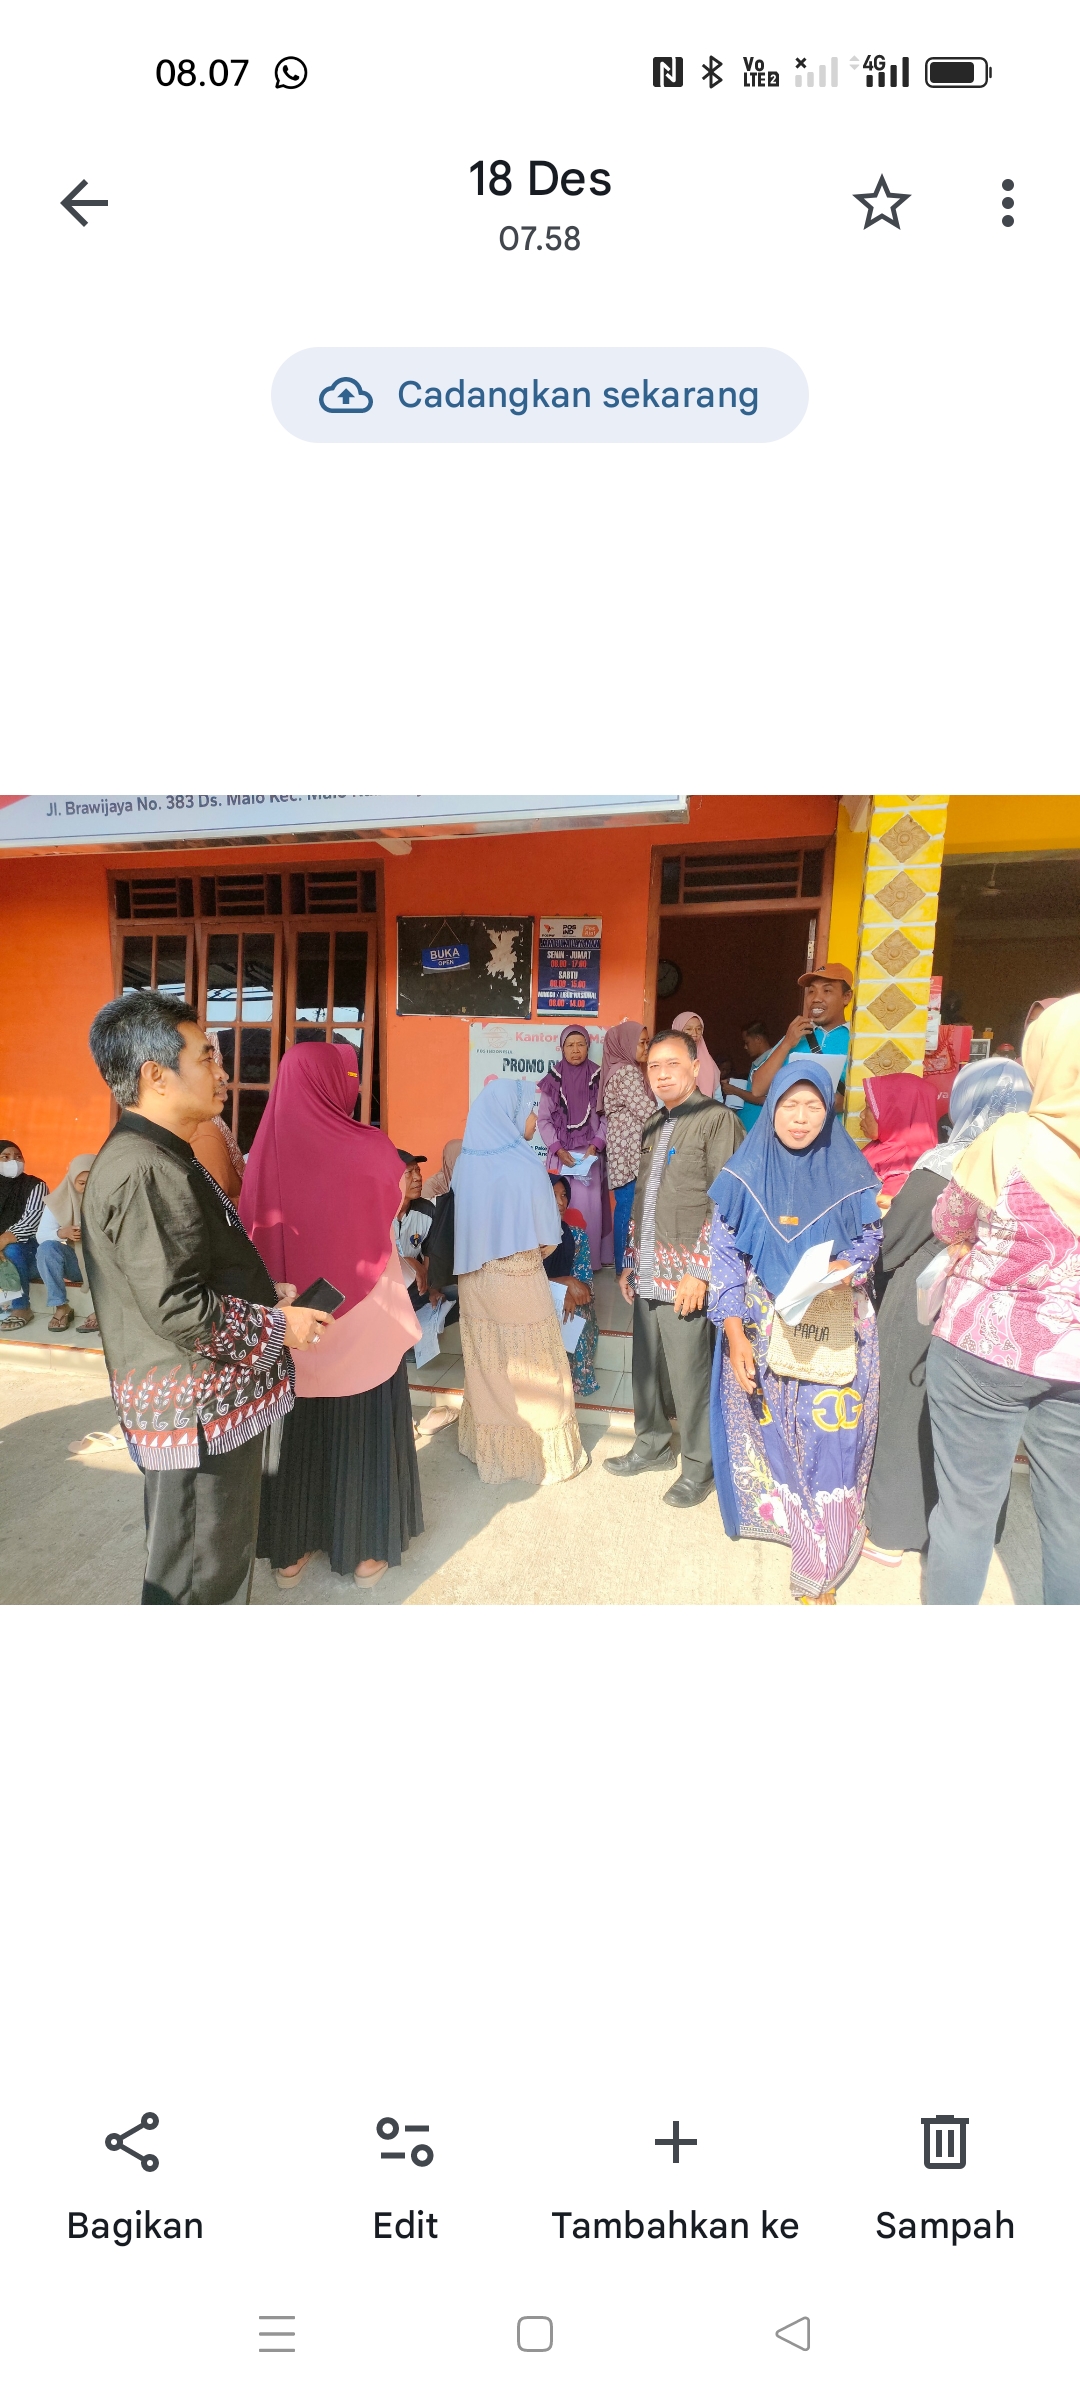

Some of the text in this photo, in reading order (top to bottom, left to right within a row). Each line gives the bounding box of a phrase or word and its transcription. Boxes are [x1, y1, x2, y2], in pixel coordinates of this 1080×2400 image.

[156, 59, 249, 87] 08.07
[862, 55, 886, 71] 4G
[470, 160, 612, 197] 18 Des
[499, 226, 581, 252] 07.58
[398, 378, 758, 416] Cadangkan sekarang
[46, 801, 62, 817] Jl.
[65, 798, 133, 817] Brawijaya
[136, 796, 162, 811] No.
[166, 795, 194, 810] 383
[198, 795, 222, 808] Ds.
[430, 947, 460, 960] BUKA
[547, 950, 565, 959] SENIN
[570, 950, 592, 960] JUMAT
[558, 970, 579, 980] SABTU
[515, 1031, 558, 1043] Kantor
[502, 1057, 545, 1074] PROMO
[793, 1322, 829, 1342] PAPUA
[68, 2209, 203, 2247] Bagikan
[374, 2209, 438, 2240] Edit
[551, 2209, 799, 2240] Tambahkan ke
[876, 2209, 1014, 2247] Sampah
